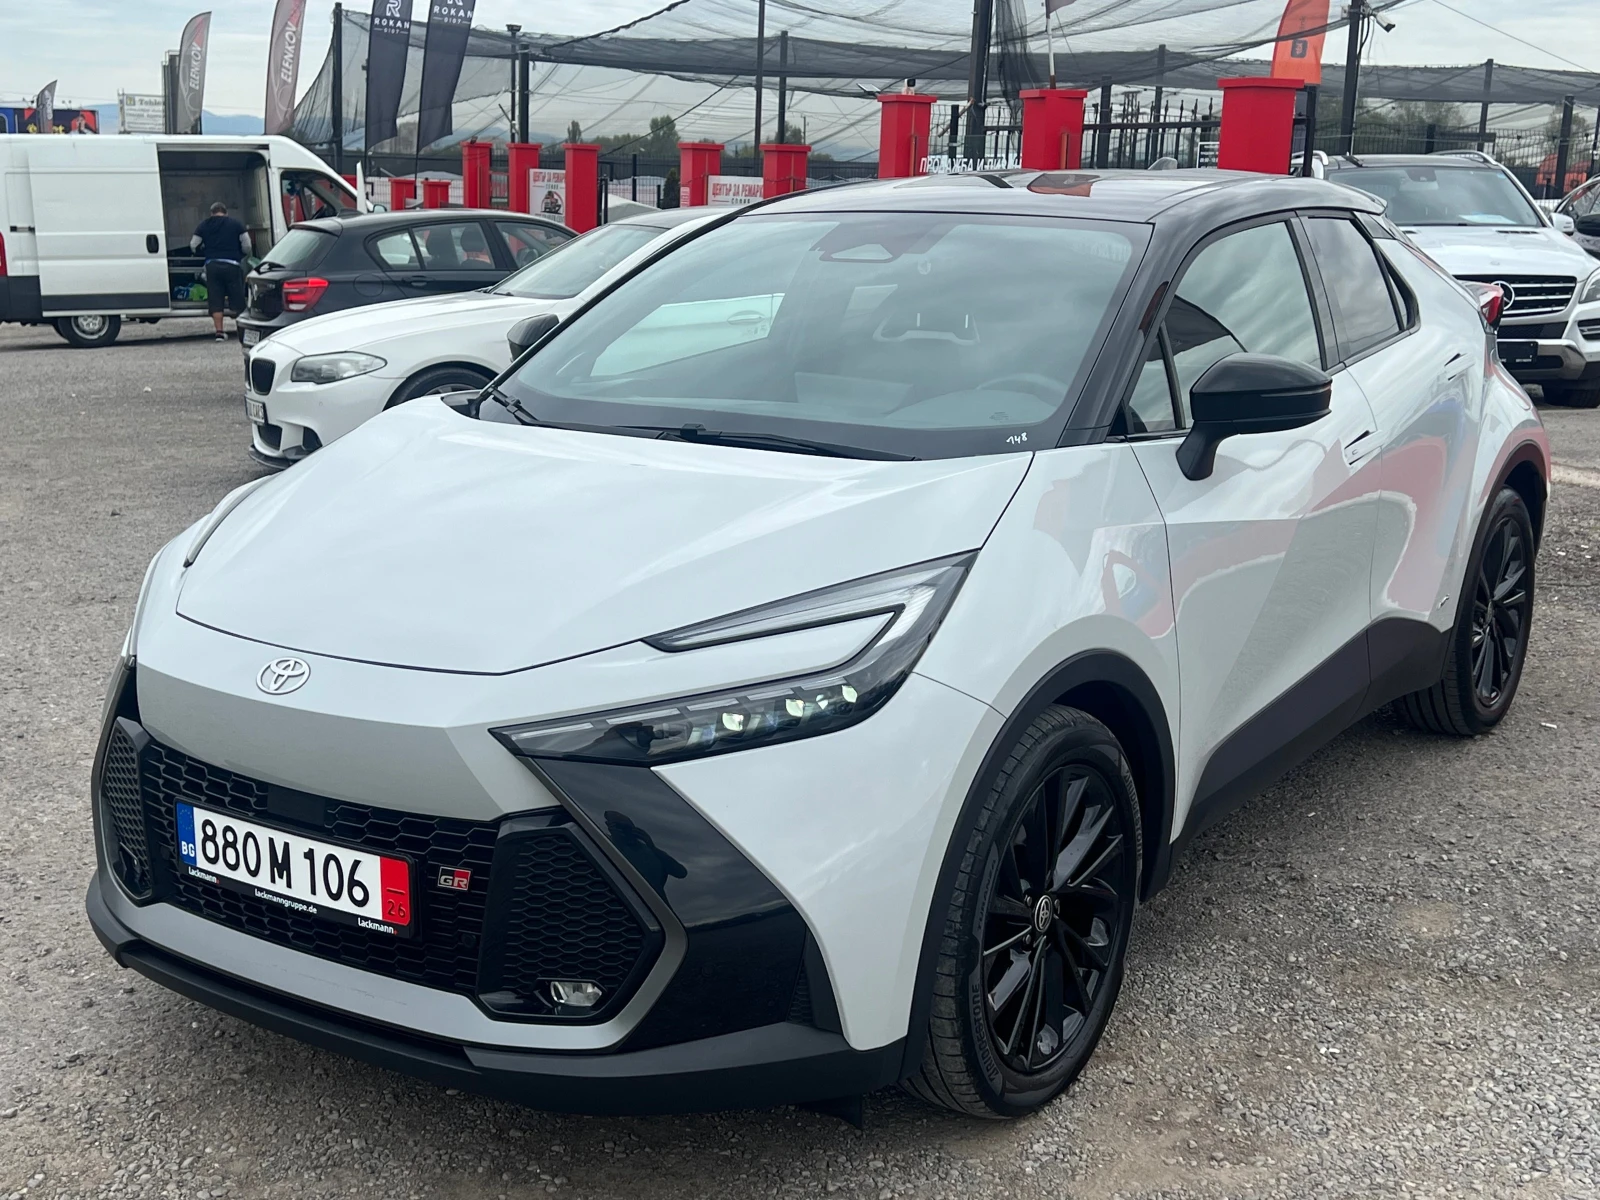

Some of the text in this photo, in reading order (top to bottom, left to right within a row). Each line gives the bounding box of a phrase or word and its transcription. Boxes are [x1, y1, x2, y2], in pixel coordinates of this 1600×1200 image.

[433, 5, 473, 19] ROKAN
[374, 17, 410, 29] ROKAN
[281, 21, 297, 83] ELENKOV
[189, 42, 202, 90] ELENKOV
[919, 156, 974, 173] ПРОДАЖБА
[712, 183, 732, 197] ЦЕНТЪР
[732, 183, 740, 196] ЗА
[1006, 432, 1028, 445] 148
[181, 840, 195, 858] BG
[201, 818, 371, 908] 880 M 106
[440, 875, 468, 888] GR
[977, 858, 998, 932] TURANZA
[386, 898, 407, 919] 26
[357, 917, 395, 935] Lackmann
